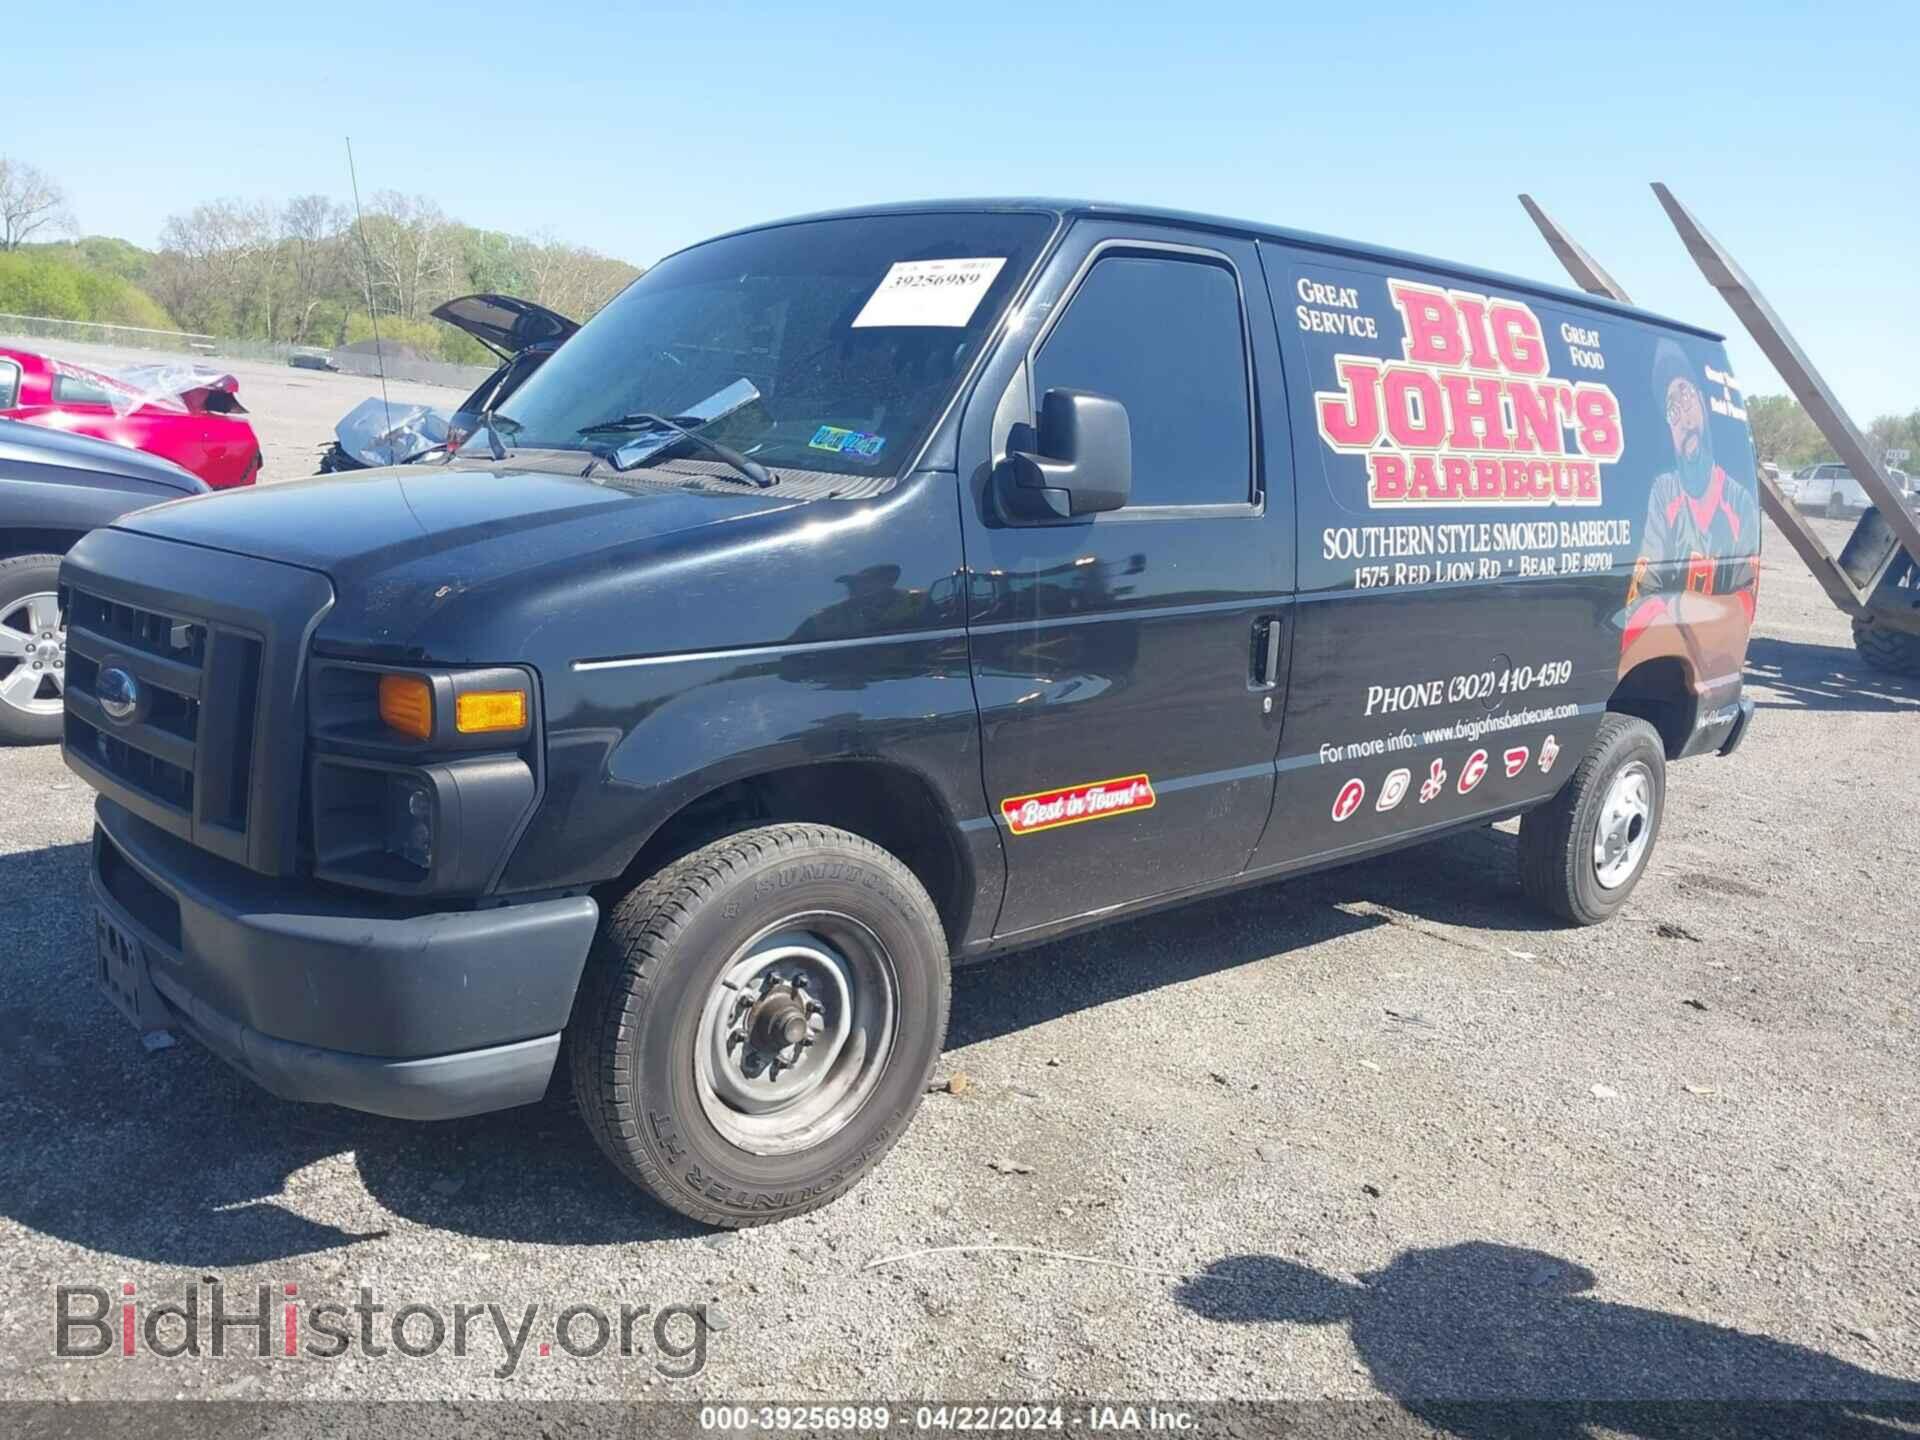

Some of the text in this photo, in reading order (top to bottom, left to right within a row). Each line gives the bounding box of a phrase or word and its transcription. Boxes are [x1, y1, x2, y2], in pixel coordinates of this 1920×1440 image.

[1297, 278, 1359, 309] GREAT
[1297, 305, 1378, 339] SERVICE
[1387, 278, 1549, 379] BIG
[1561, 323, 1600, 348] GREAT
[1569, 345, 1605, 370] FOOD
[1315, 354, 1624, 464] JOHN'S
[1367, 453, 1602, 509] BARBECUE
[1323, 520, 1631, 560] SOUTHERN STYLE SMOKED BARBECUE
[1354, 552, 1613, 589] 1575 RED LION RD BEAR, DE 19701
[1363, 660, 1572, 716] PHONE (302) 440-4519
[1320, 703, 1579, 764] For more info: www.bigjohnsbarbecue.com
[1021, 780, 1138, 827] Best in Town!
